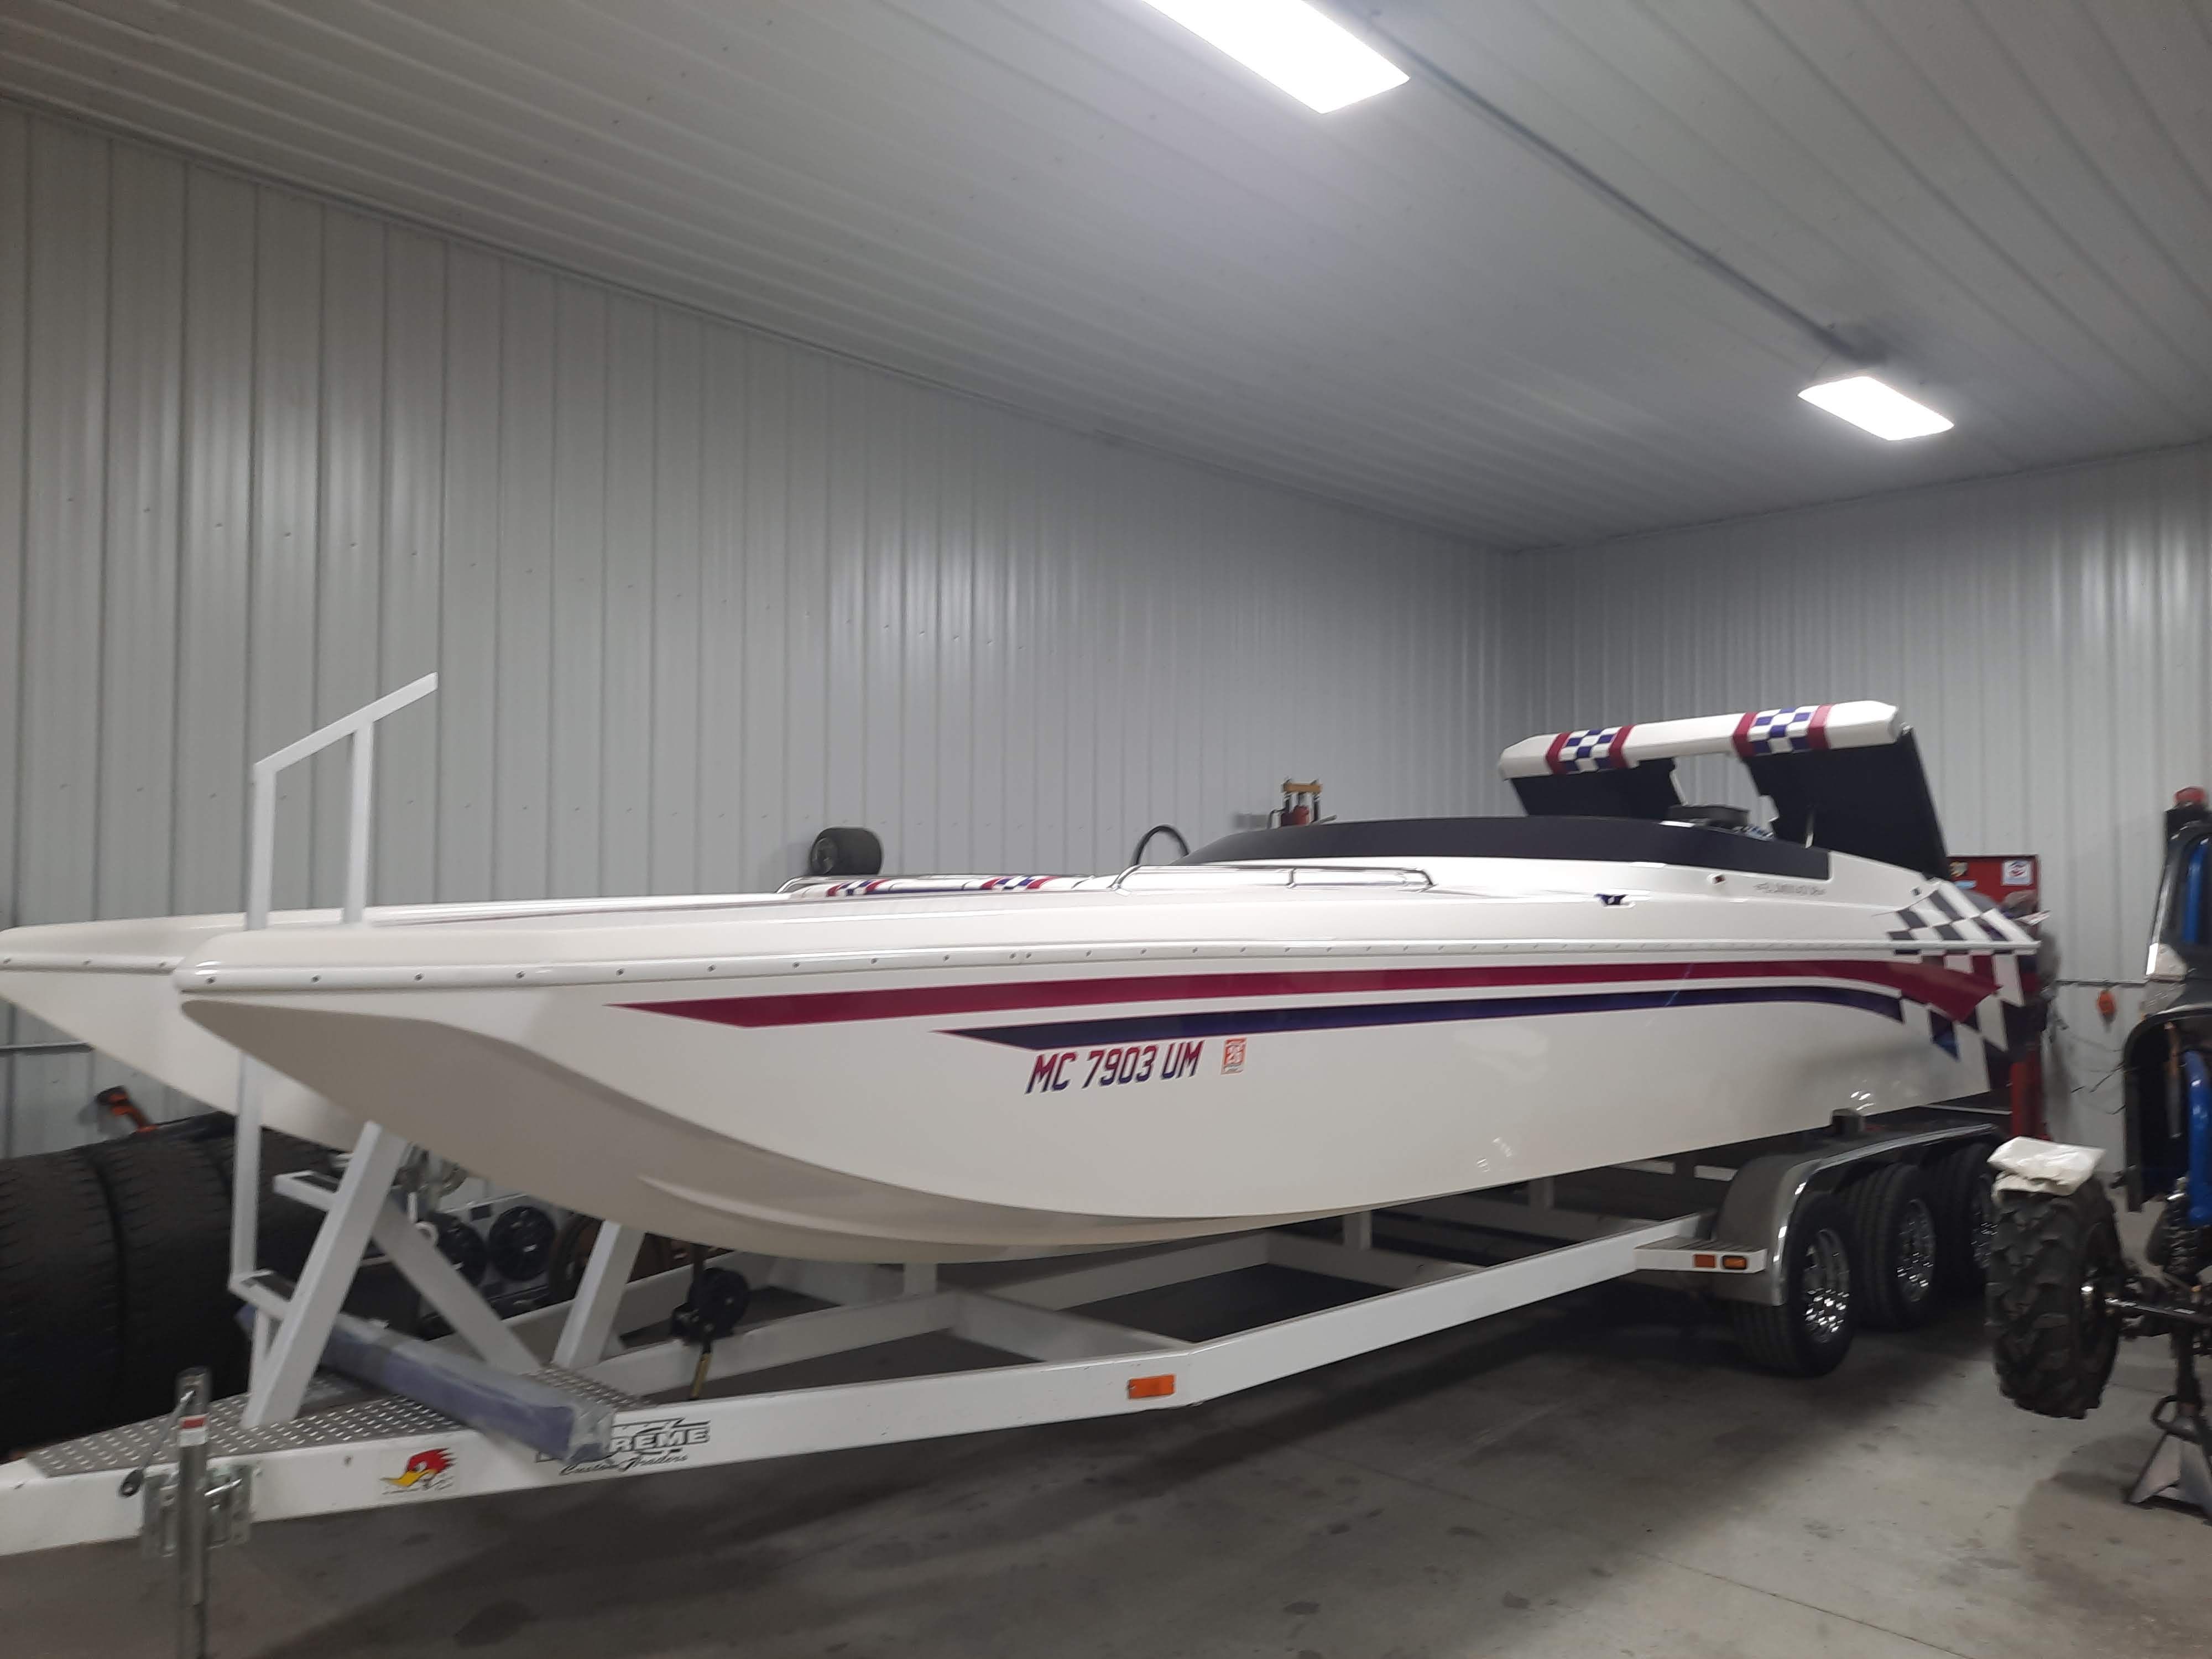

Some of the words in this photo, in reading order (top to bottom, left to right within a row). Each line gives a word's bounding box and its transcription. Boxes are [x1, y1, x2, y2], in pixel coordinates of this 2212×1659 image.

[1025, 1052, 1077, 1094] MC
[1082, 1044, 1158, 1088] 7903
[1160, 1040, 1204, 1079] UM
